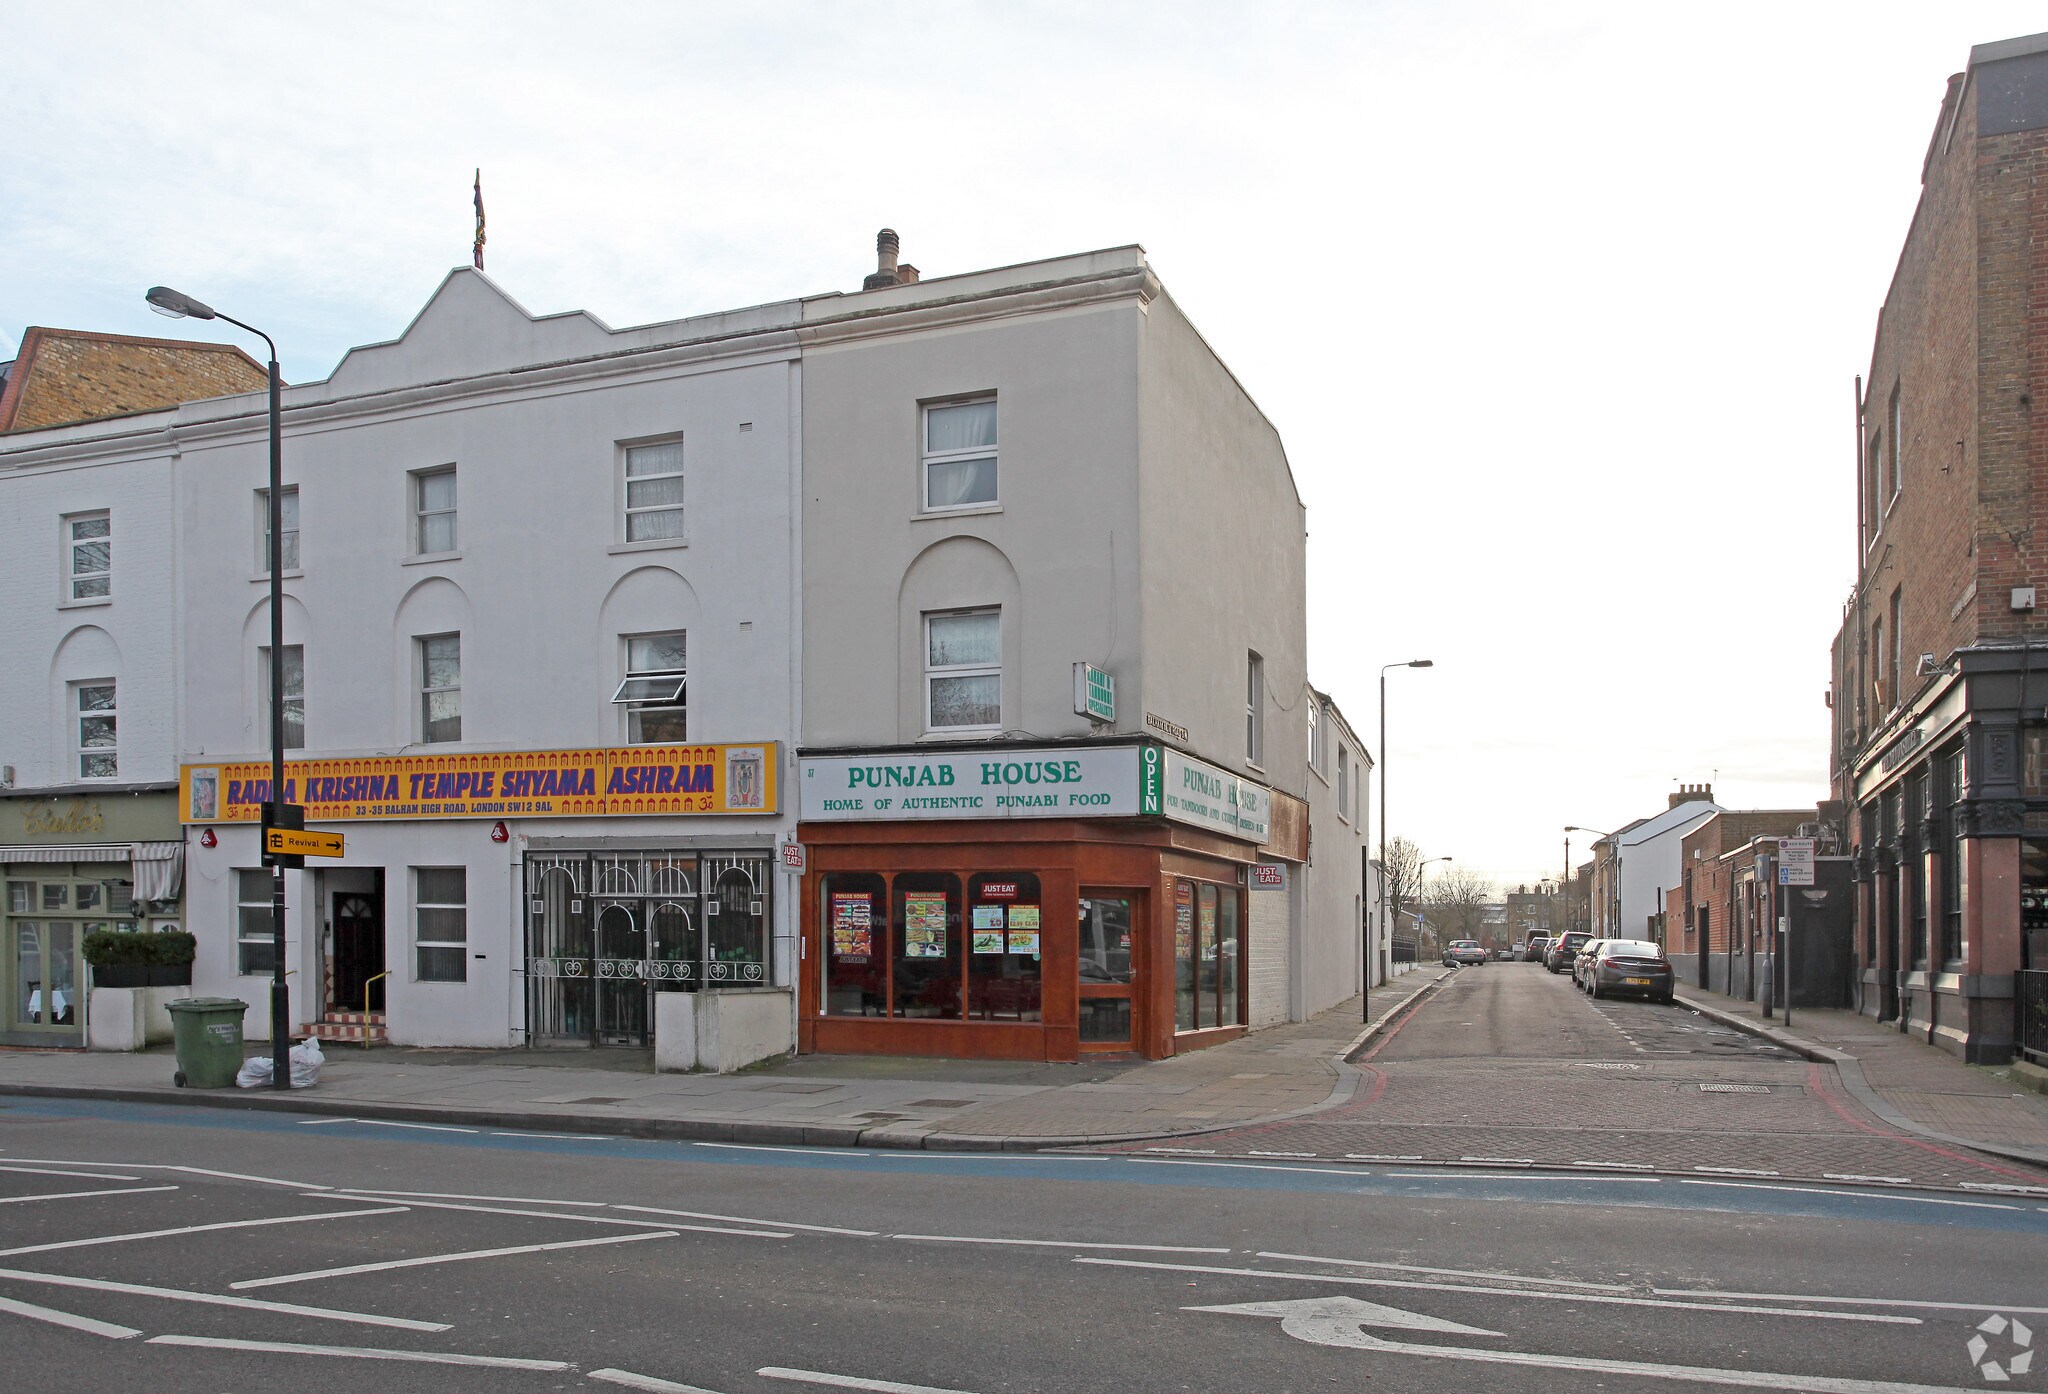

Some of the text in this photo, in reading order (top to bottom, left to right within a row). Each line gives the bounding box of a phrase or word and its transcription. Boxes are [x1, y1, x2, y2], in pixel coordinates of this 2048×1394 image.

[808, 768, 815, 778] 37
[849, 761, 1082, 788] PUNJAB HOUSE
[1144, 748, 1157, 812] OPEN
[305, 775, 400, 803] KRISHNA
[410, 770, 496, 800] TEMPLE
[500, 768, 596, 798] SHYAMA
[607, 764, 715, 795] ASHRAM
[1183, 766, 1221, 800] PUNJAB
[355, 806, 366, 816] 33
[386, 804, 418, 816] BALHAM
[421, 803, 440, 814] HIGH
[443, 803, 468, 814] ROAD,
[471, 803, 504, 813] LONDON
[507, 801, 532, 813] SW12
[535, 801, 552, 812] 9AL
[824, 793, 1111, 811] HOME OF AUTHENTIC PUNJABI FOOD
[1166, 794, 1178, 807] FOR
[1181, 799, 1208, 817] TANDOORI
[1209, 808, 1220, 821] AND
[288, 837, 320, 848] Revival
[784, 846, 798, 856] JUST
[787, 856, 798, 865] EAT
[1255, 867, 1276, 875] JUST
[1260, 875, 1276, 883] EAT
